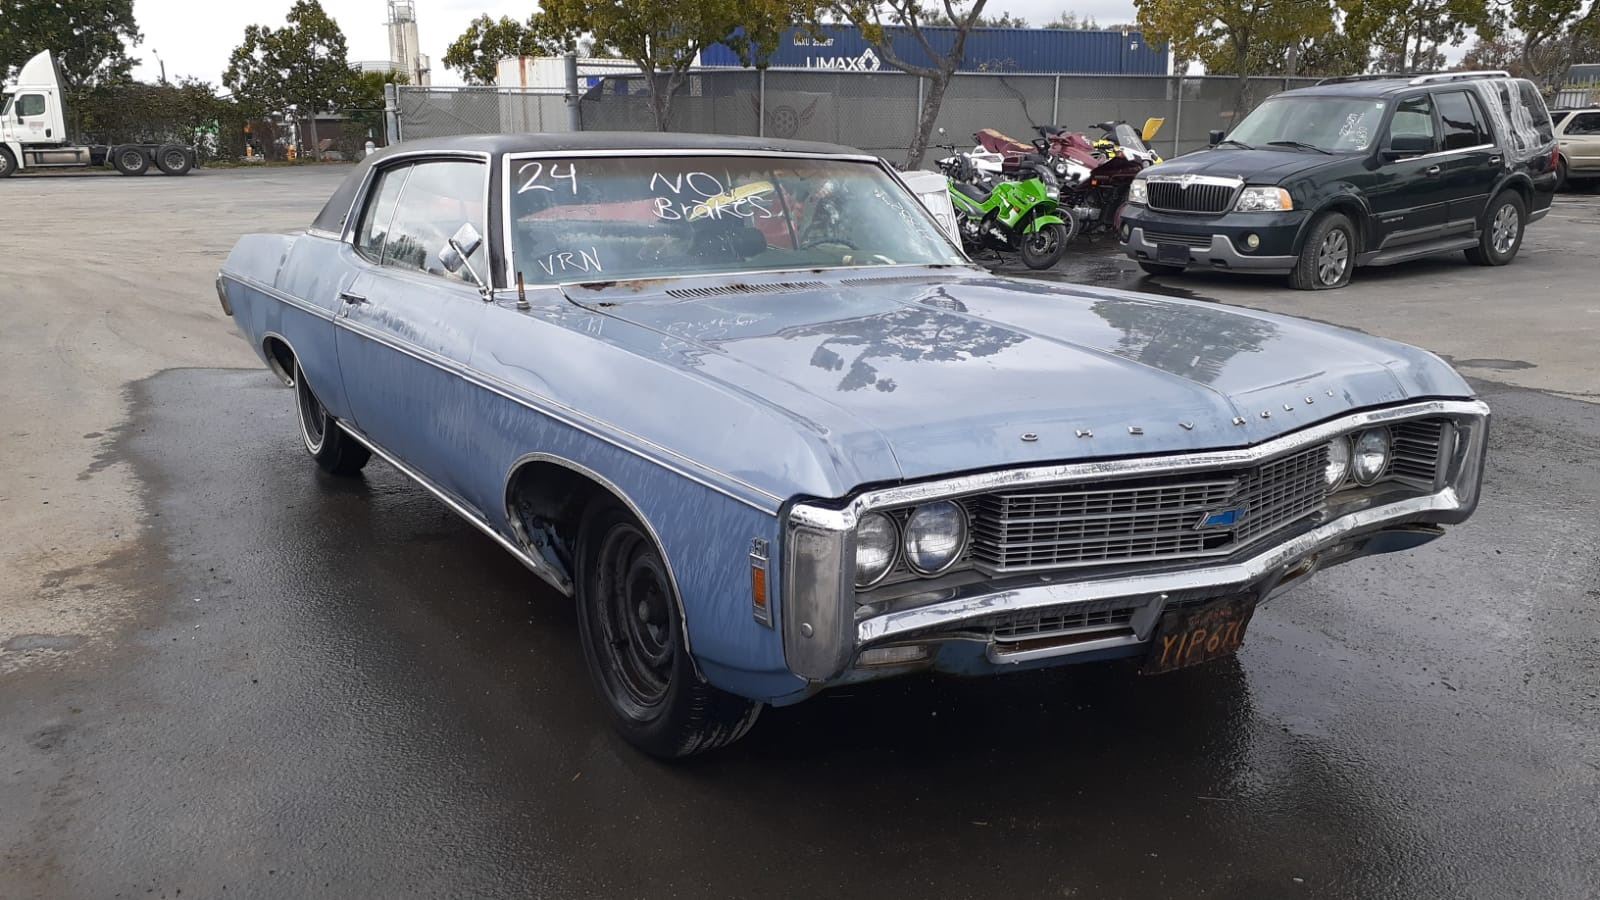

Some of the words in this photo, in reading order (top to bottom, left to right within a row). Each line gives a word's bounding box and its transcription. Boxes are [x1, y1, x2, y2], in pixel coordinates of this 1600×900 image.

[517, 162, 577, 195] 24
[650, 171, 723, 197] NO
[537, 247, 602, 276] VRN
[1020, 388, 1334, 442] CHEVROLET
